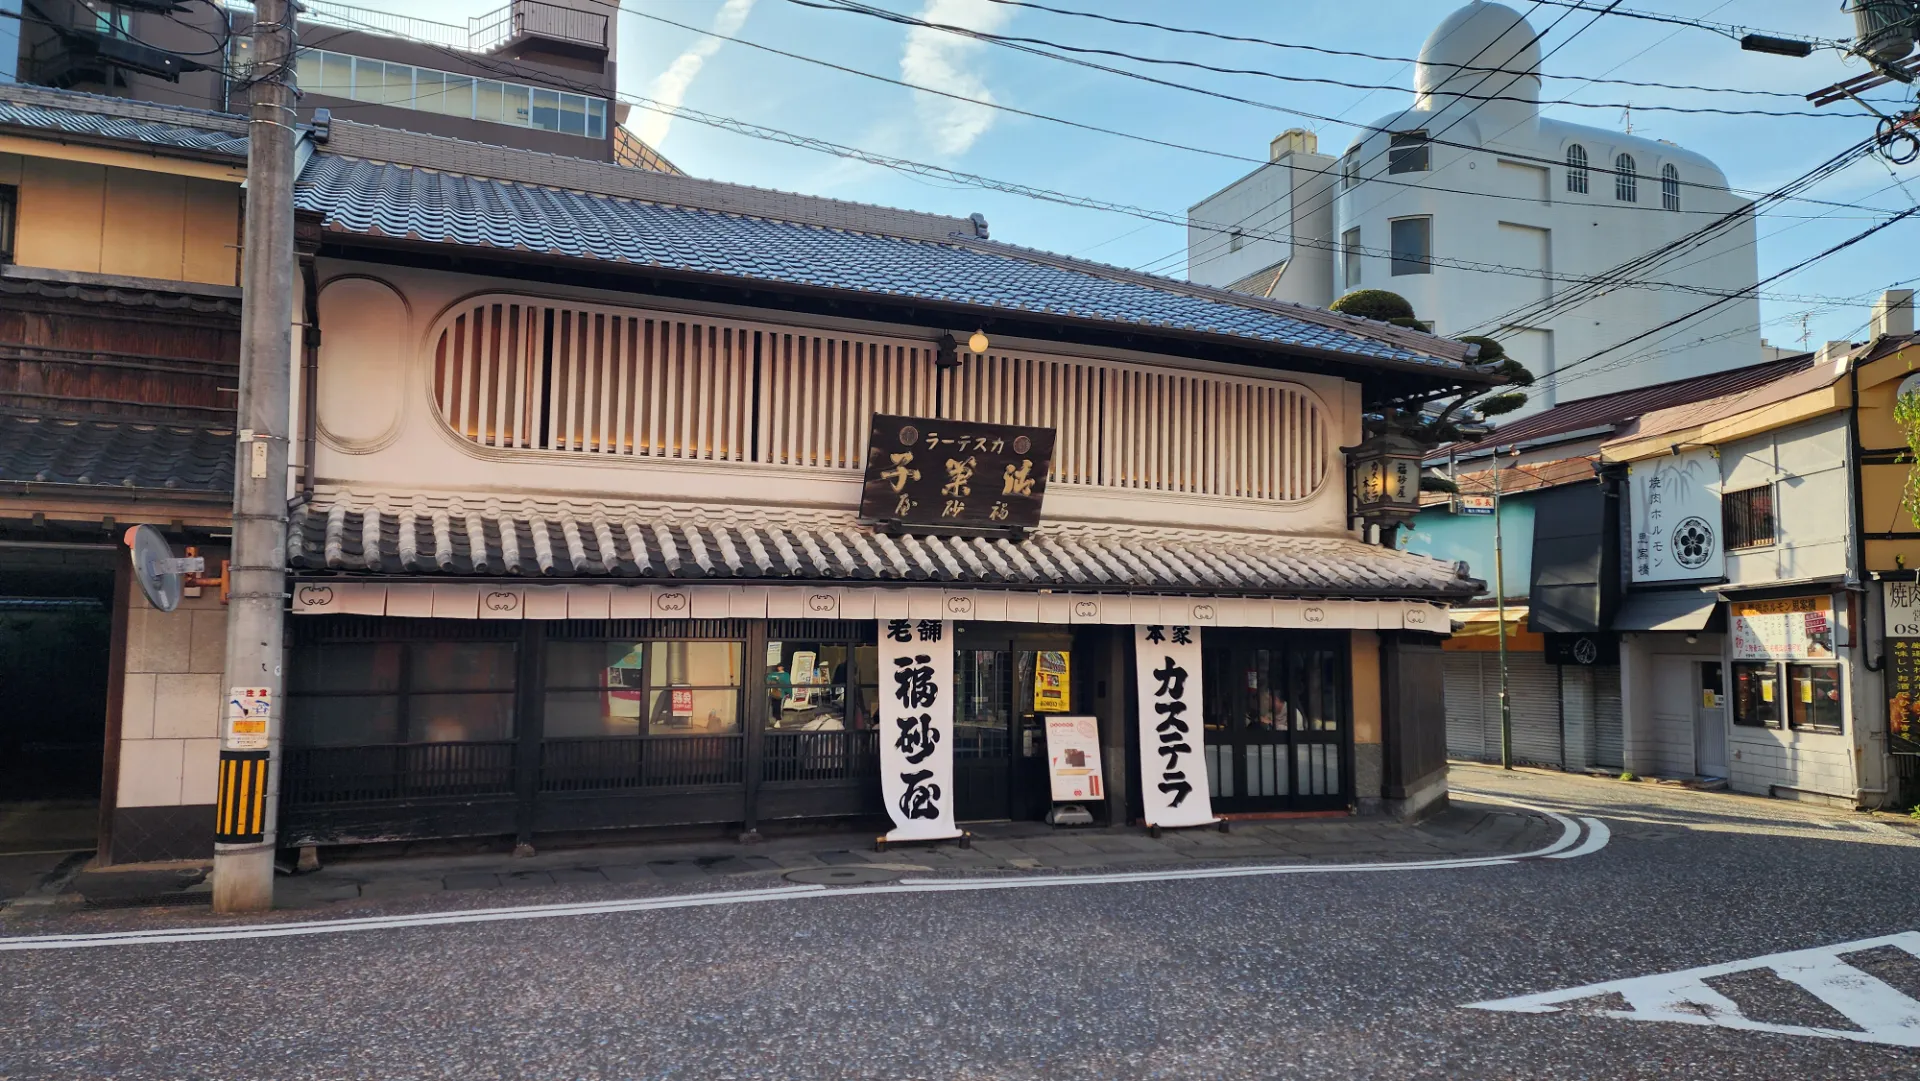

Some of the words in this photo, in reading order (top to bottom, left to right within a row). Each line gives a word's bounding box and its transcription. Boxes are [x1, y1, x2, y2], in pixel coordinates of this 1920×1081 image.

[1648, 477, 1663, 568] 焼肉ホルモン
[1145, 626, 1193, 645] 本家
[893, 654, 941, 820] 福砂屋
[1153, 656, 1193, 808] カステラ
